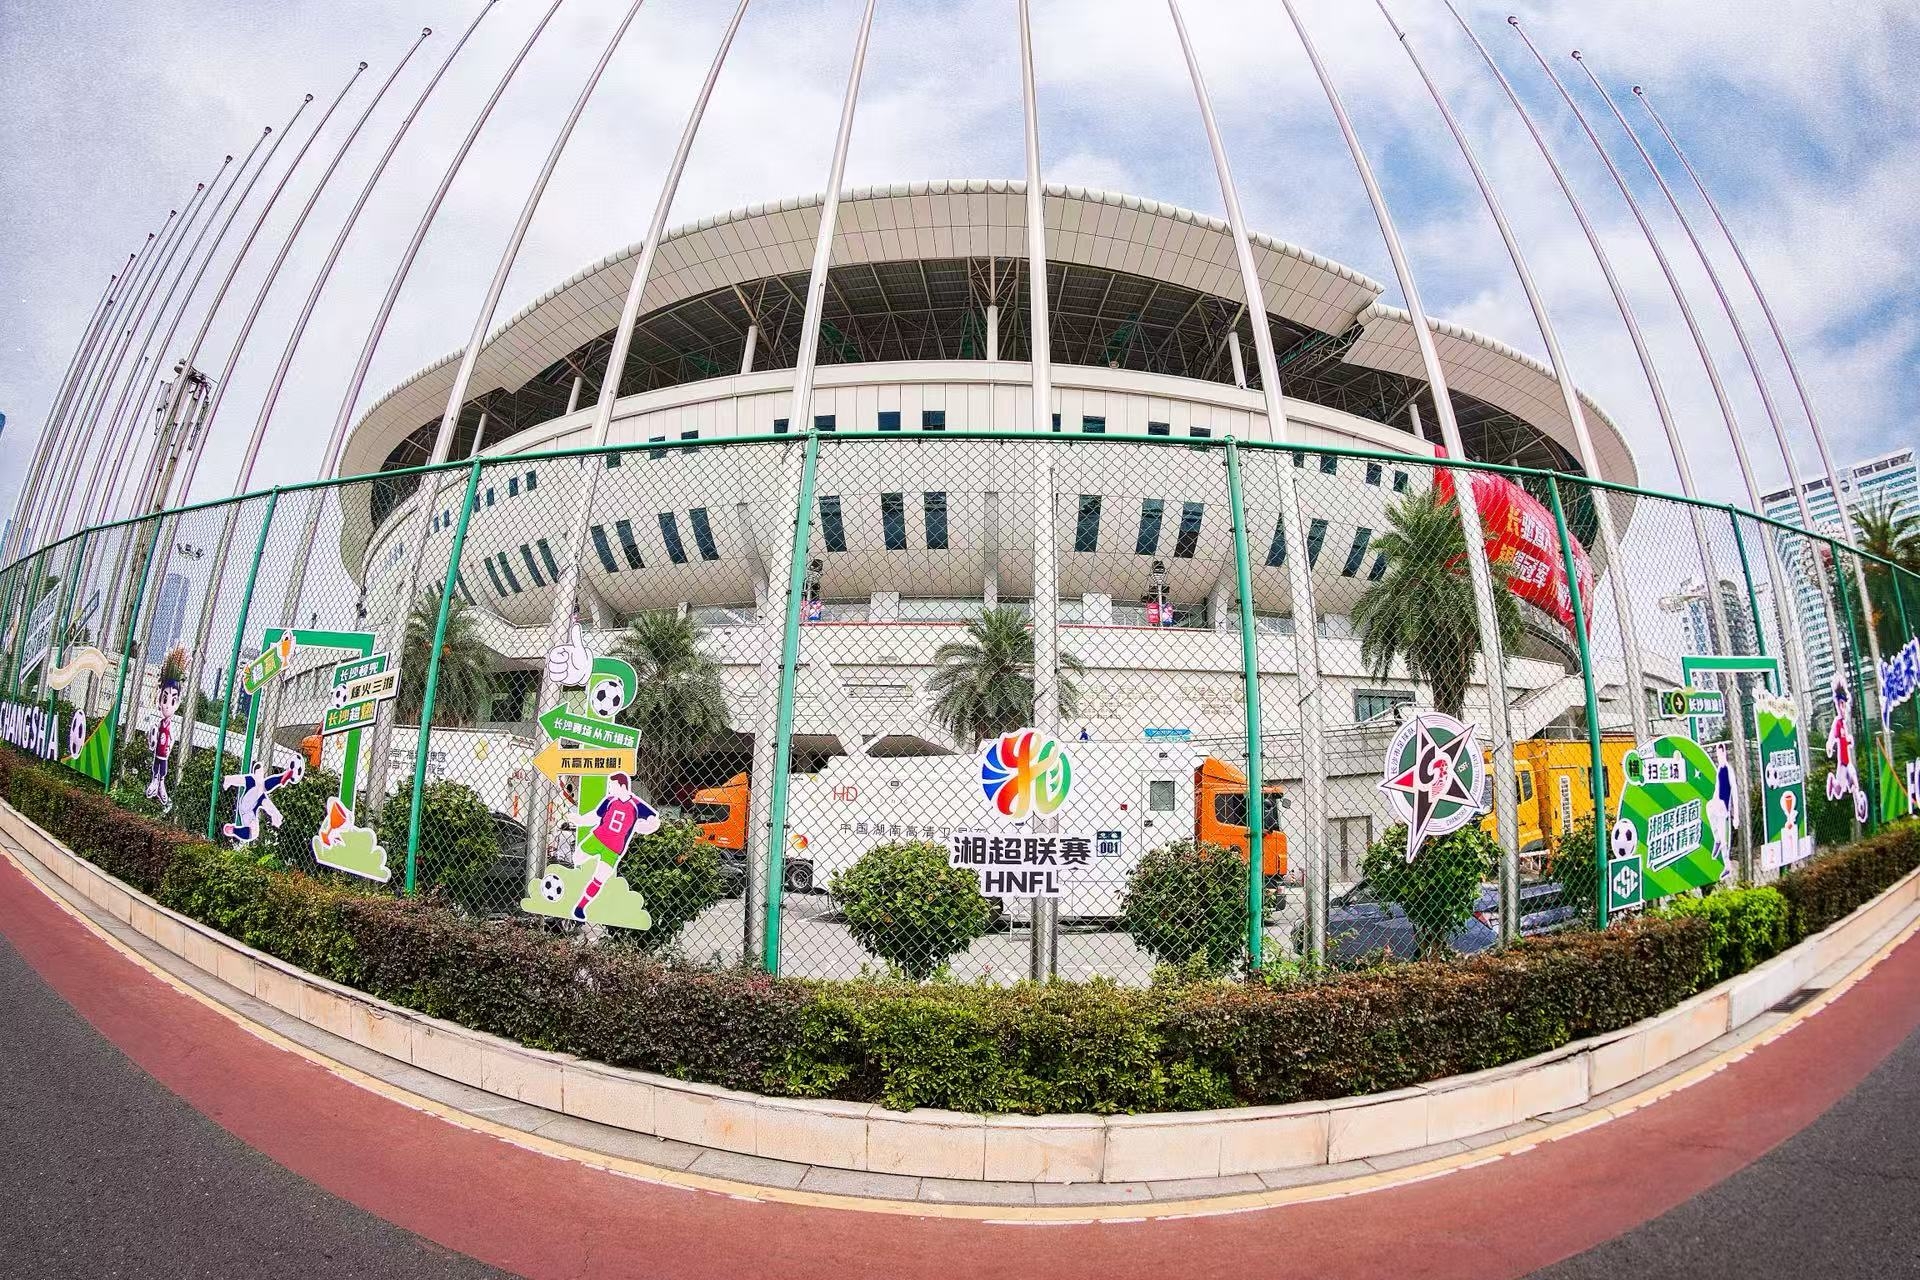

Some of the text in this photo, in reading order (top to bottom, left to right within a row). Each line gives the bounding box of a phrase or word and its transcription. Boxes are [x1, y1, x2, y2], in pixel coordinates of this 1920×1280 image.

[833, 786, 858, 802] HD
[608, 809, 626, 834] 6
[952, 836, 1092, 866] 湘超联赛
[1099, 841, 1119, 855] 001
[984, 870, 1060, 894] HNFL
